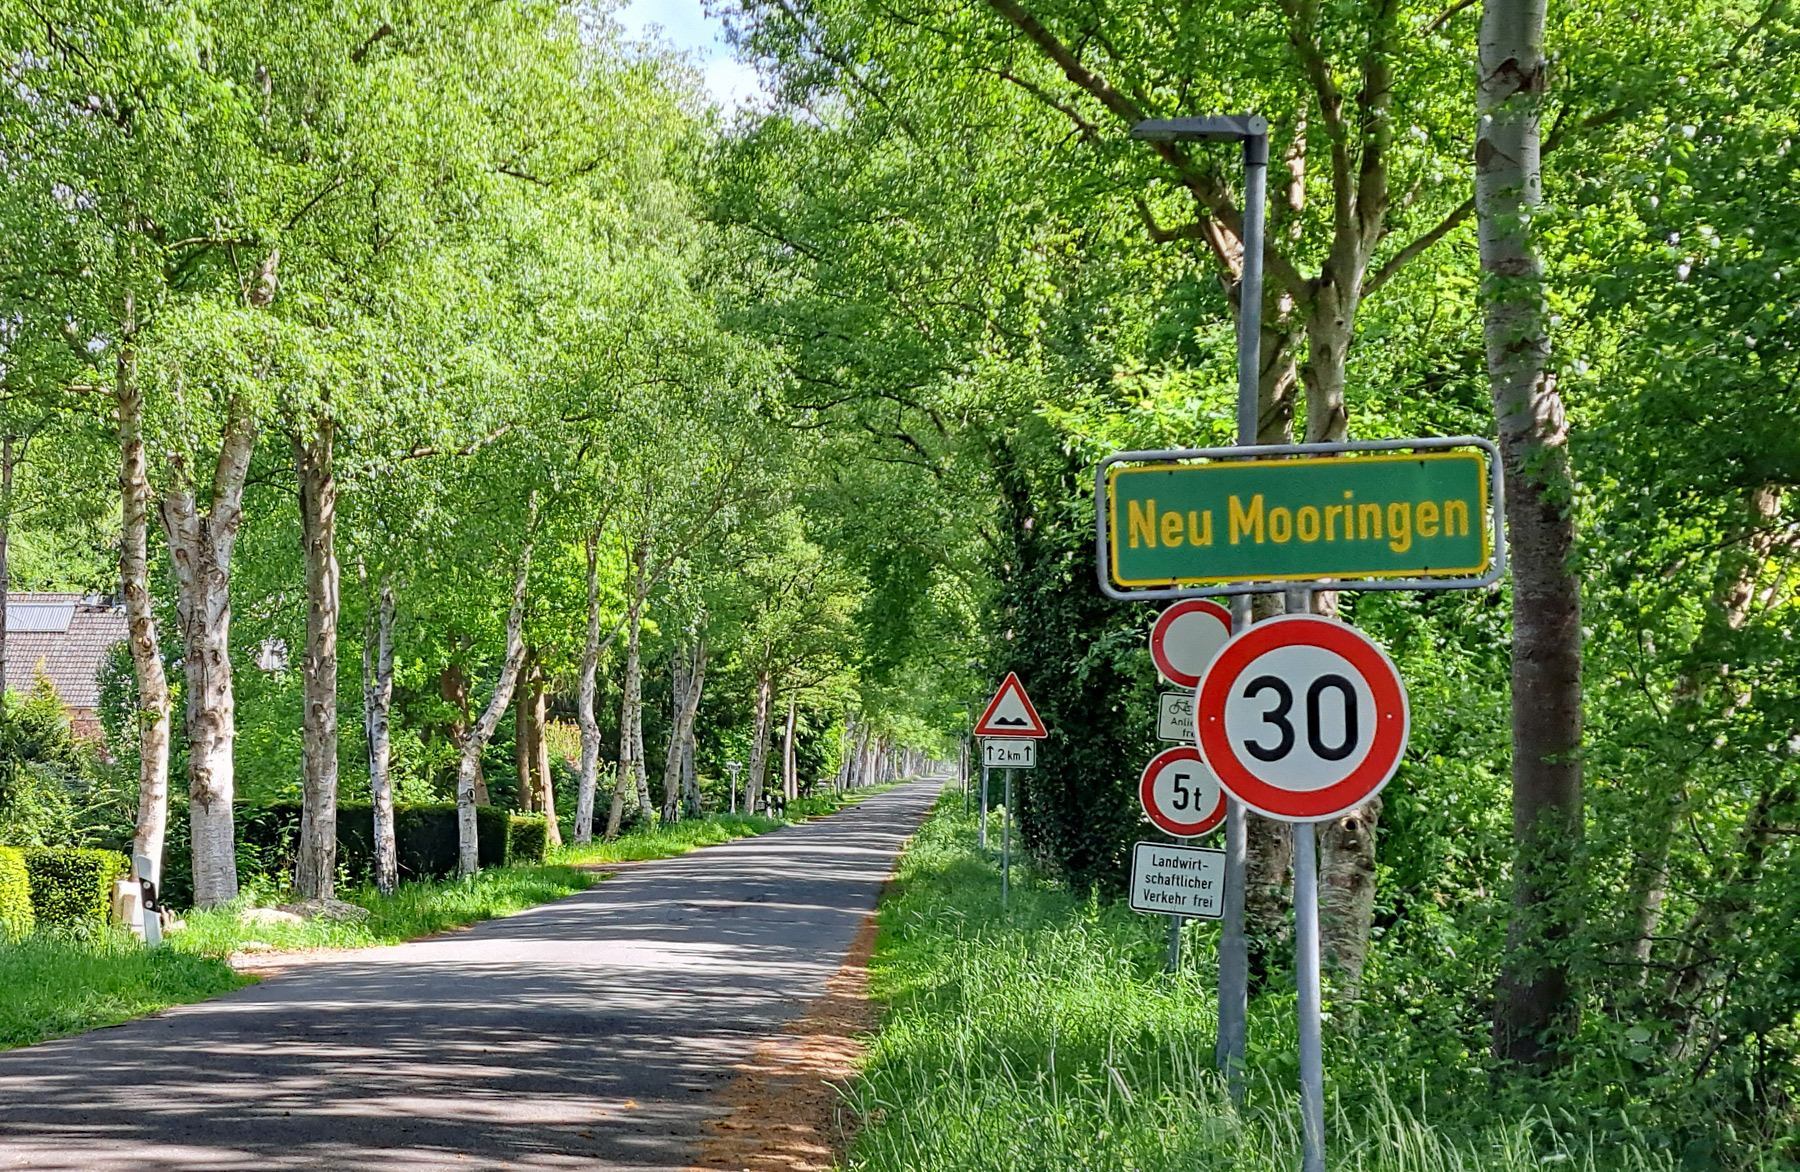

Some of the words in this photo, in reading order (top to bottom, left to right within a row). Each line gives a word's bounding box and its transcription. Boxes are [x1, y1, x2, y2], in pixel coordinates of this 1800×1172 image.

[1128, 499, 1213, 549] Neu
[1228, 490, 1469, 553] Mooringen
[1243, 674, 1358, 762] 30
[998, 748, 1005, 761] 2
[1008, 750, 1021, 761] km
[1172, 773, 1191, 810] 5
[1193, 786, 1202, 812] t
[1152, 854, 1209, 871] Landwirt-
[1145, 873, 1213, 890] schaftlicher
[1143, 888, 1187, 906] Verkehr
[1193, 893, 1213, 909] frei
